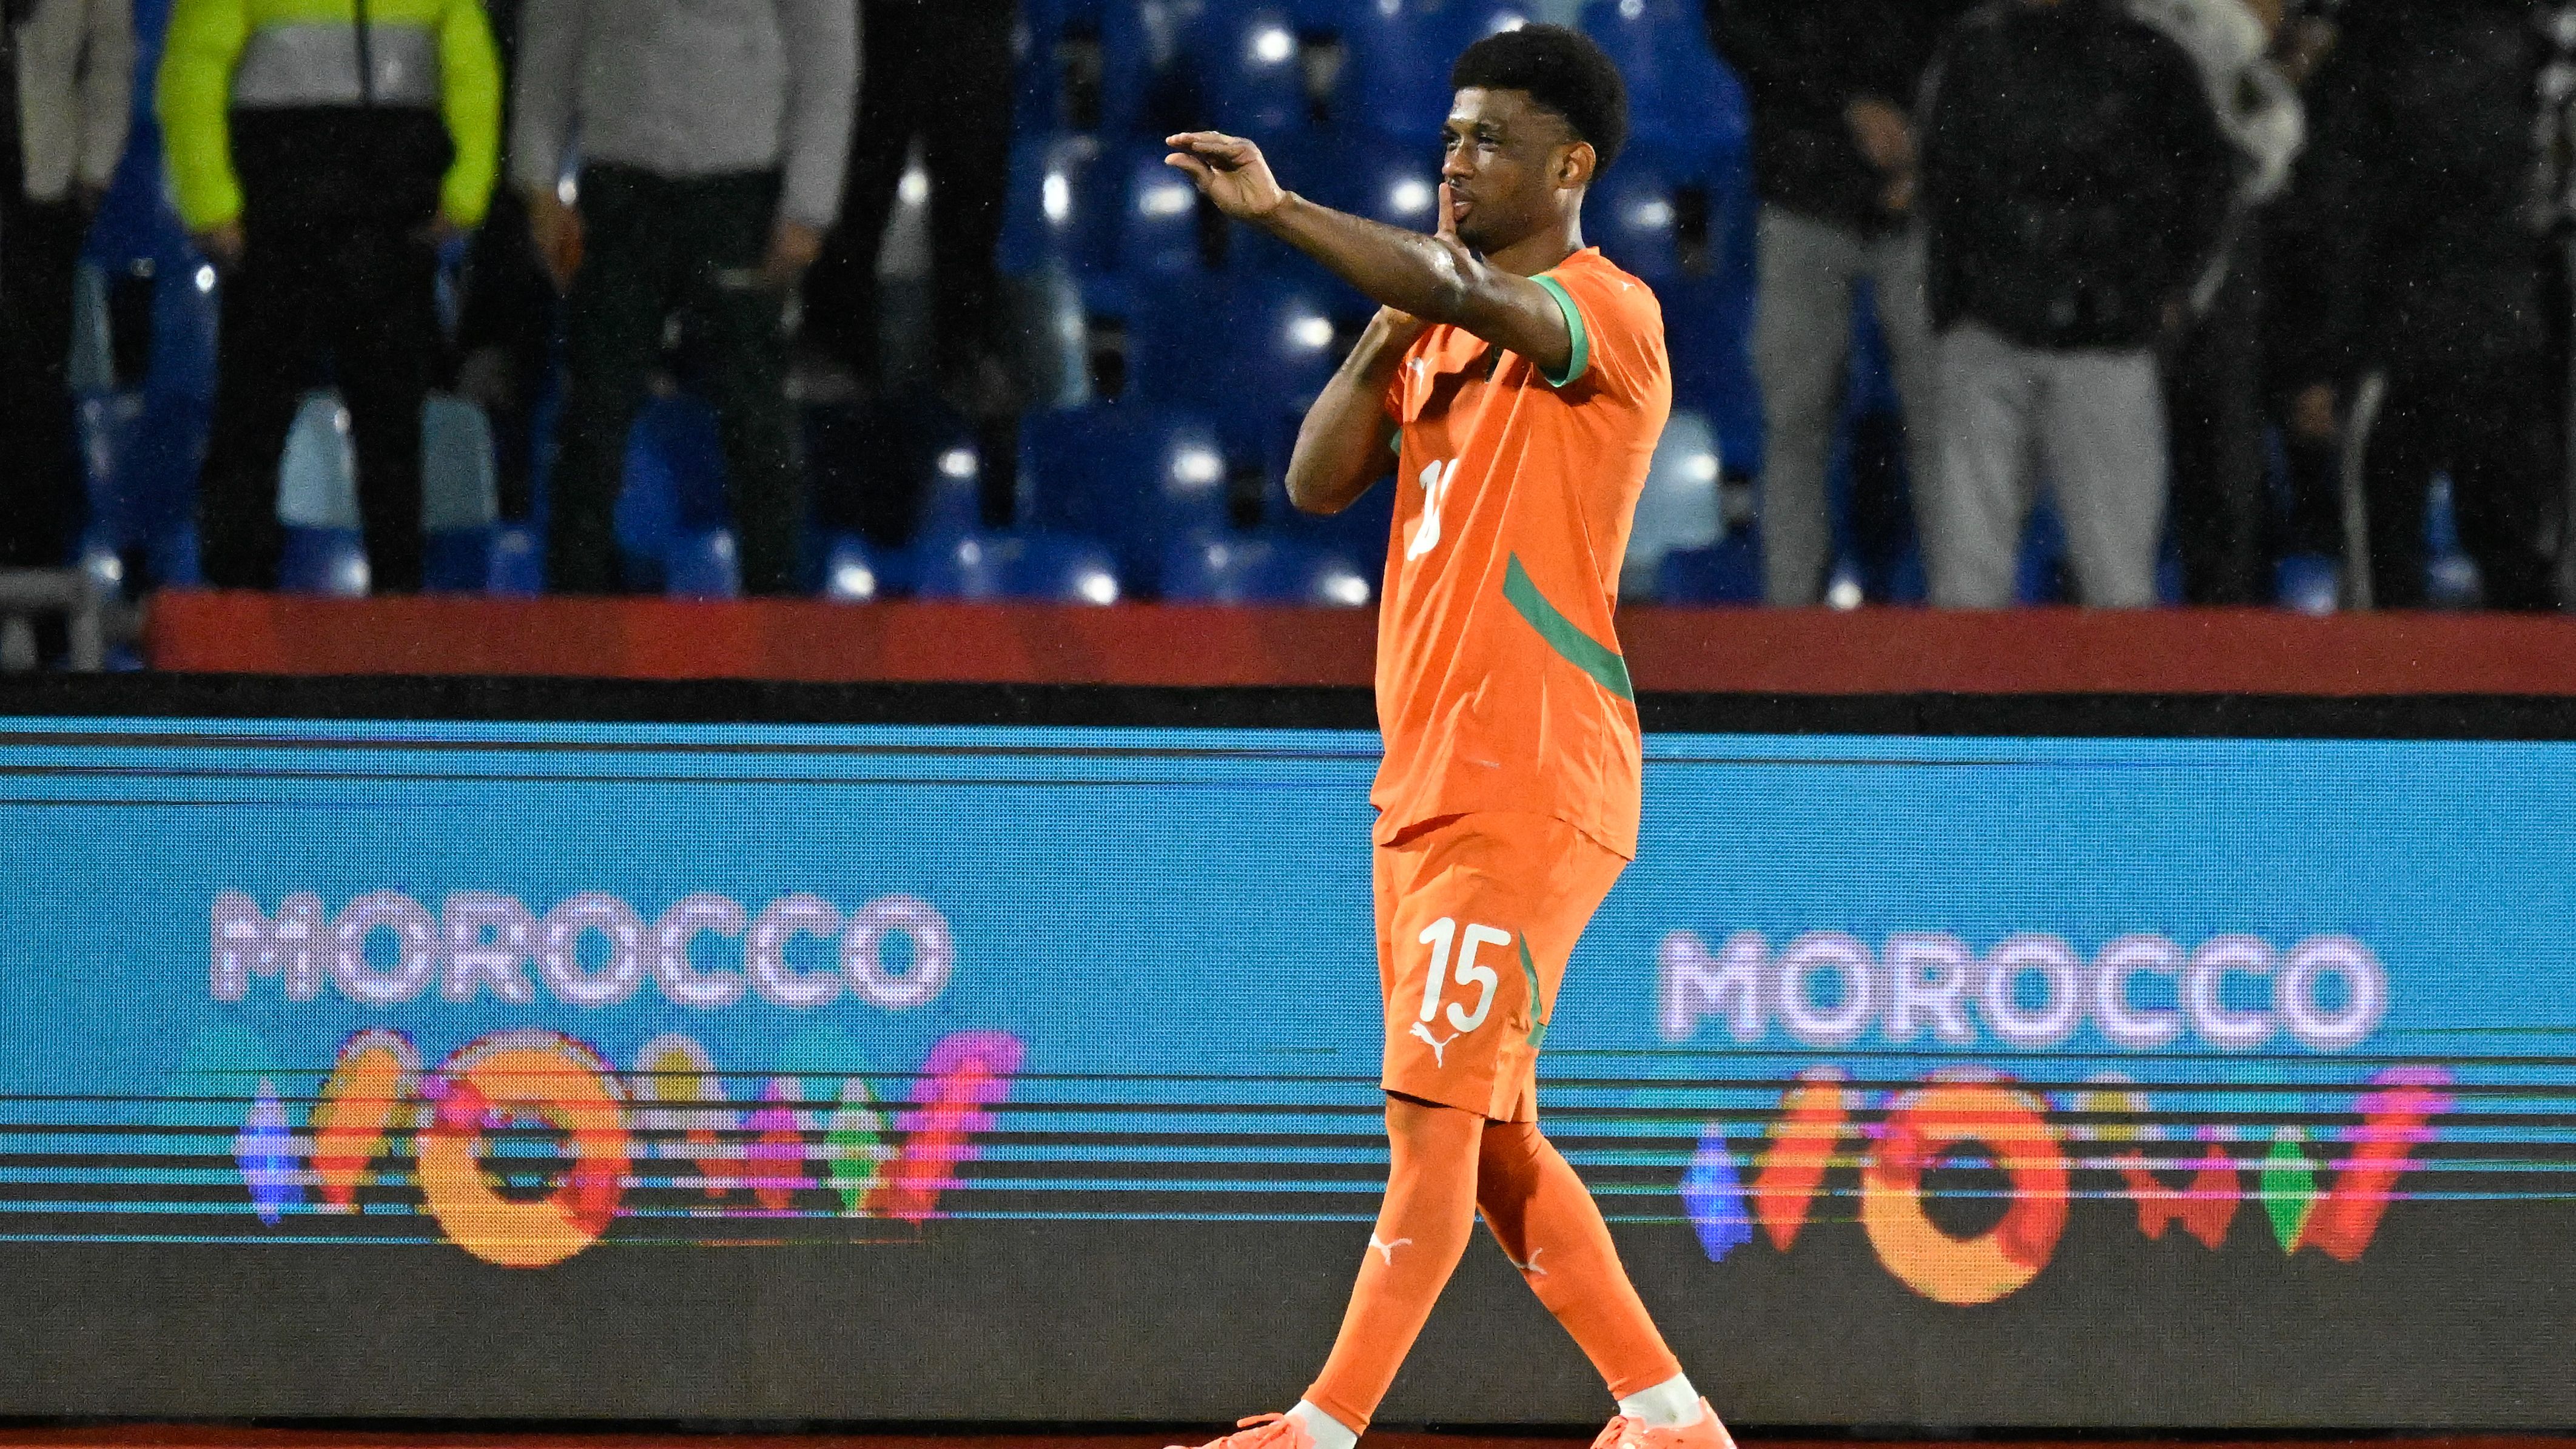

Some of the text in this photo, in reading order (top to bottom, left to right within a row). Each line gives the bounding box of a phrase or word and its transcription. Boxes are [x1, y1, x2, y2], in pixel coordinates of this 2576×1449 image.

[210, 890, 954, 1010] MOROCCO
[1419, 916, 1511, 1032] 15
[1657, 929, 2388, 1050] MOROCCO
